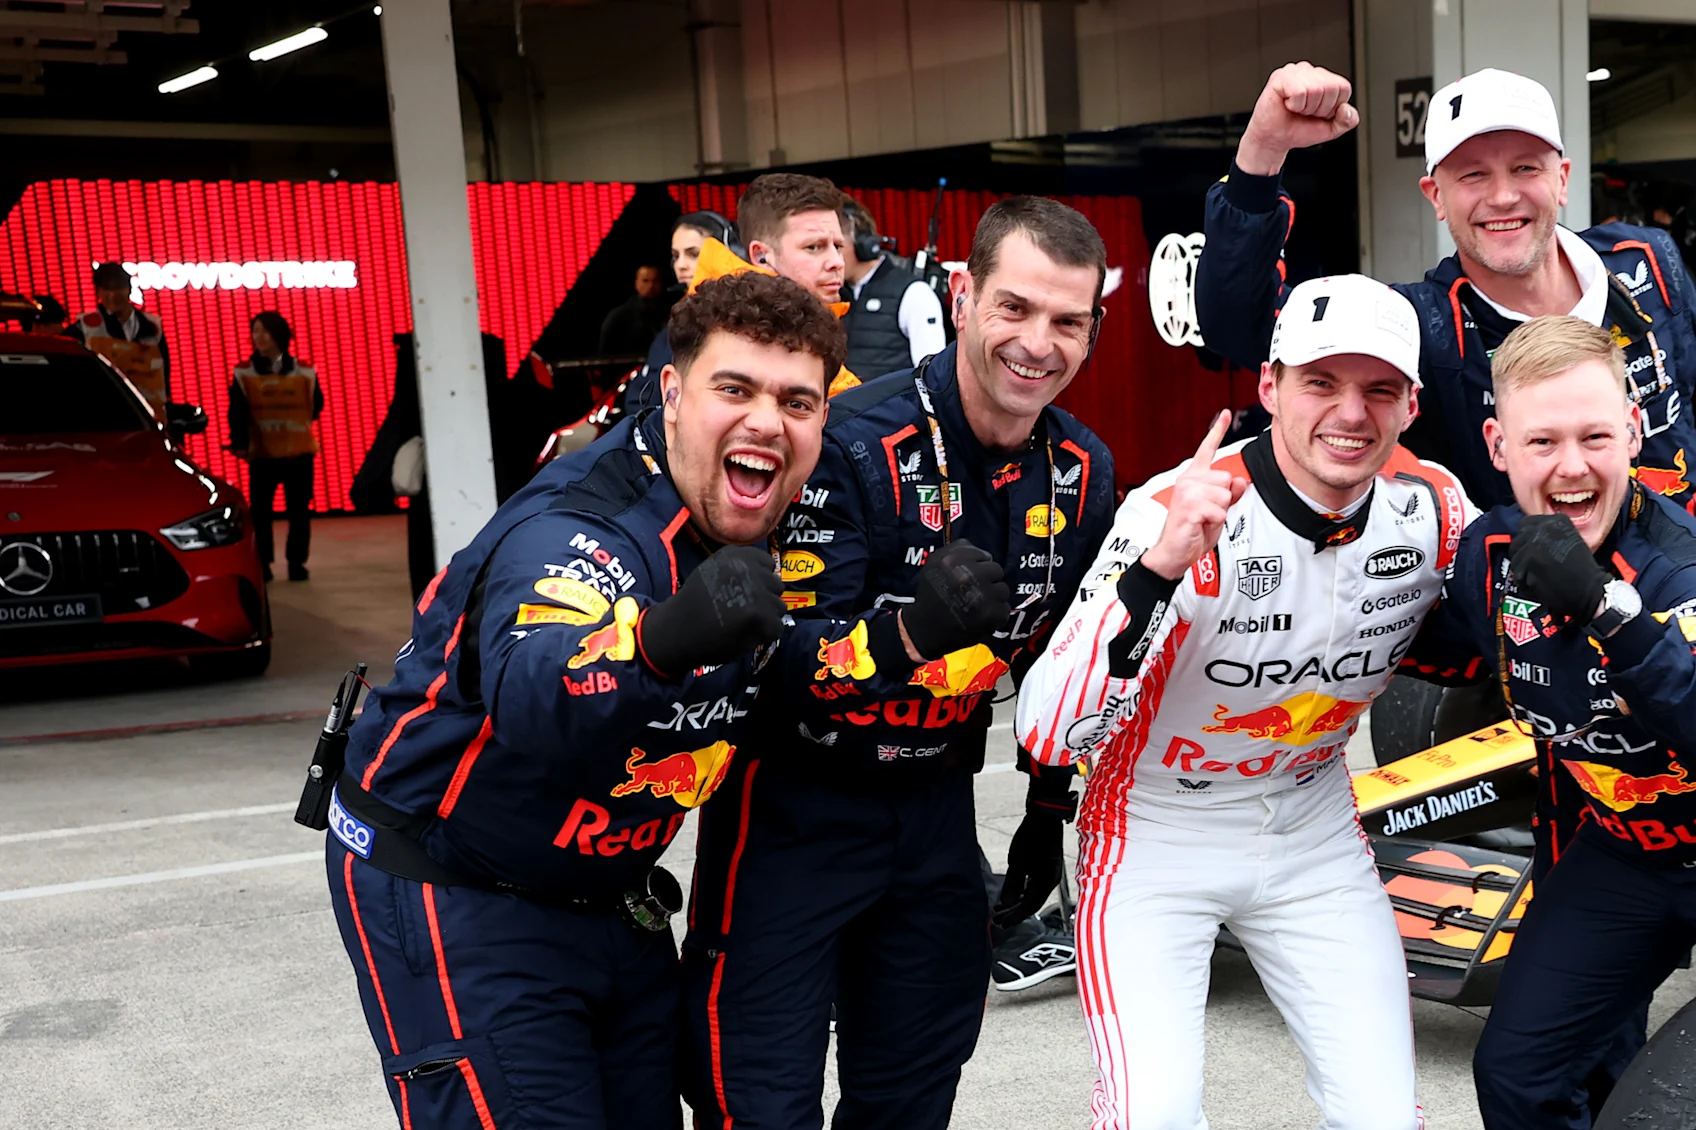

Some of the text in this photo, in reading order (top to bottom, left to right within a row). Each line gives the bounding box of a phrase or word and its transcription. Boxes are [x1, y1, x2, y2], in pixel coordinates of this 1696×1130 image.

[1449, 94, 1463, 121] 1
[133, 261, 357, 290] ROWDSTRIKE
[1312, 296, 1331, 323] 1
[1032, 514, 1060, 528] RAUH
[568, 532, 637, 593] Mobil
[781, 559, 815, 573] AUCH
[1241, 559, 1278, 573] TAG
[1378, 552, 1417, 573] RAUCH
[54, 602, 86, 616] CAR
[561, 584, 607, 615] RAUC
[1374, 588, 1422, 611] Gate.io
[1218, 615, 1269, 634] Mobil
[1358, 615, 1417, 639] HONDA
[1204, 634, 1411, 688] ORACLE
[1508, 658, 1531, 682] bil
[1383, 780, 1499, 837] JACK DANIEL'S
[330, 800, 371, 850] arco
